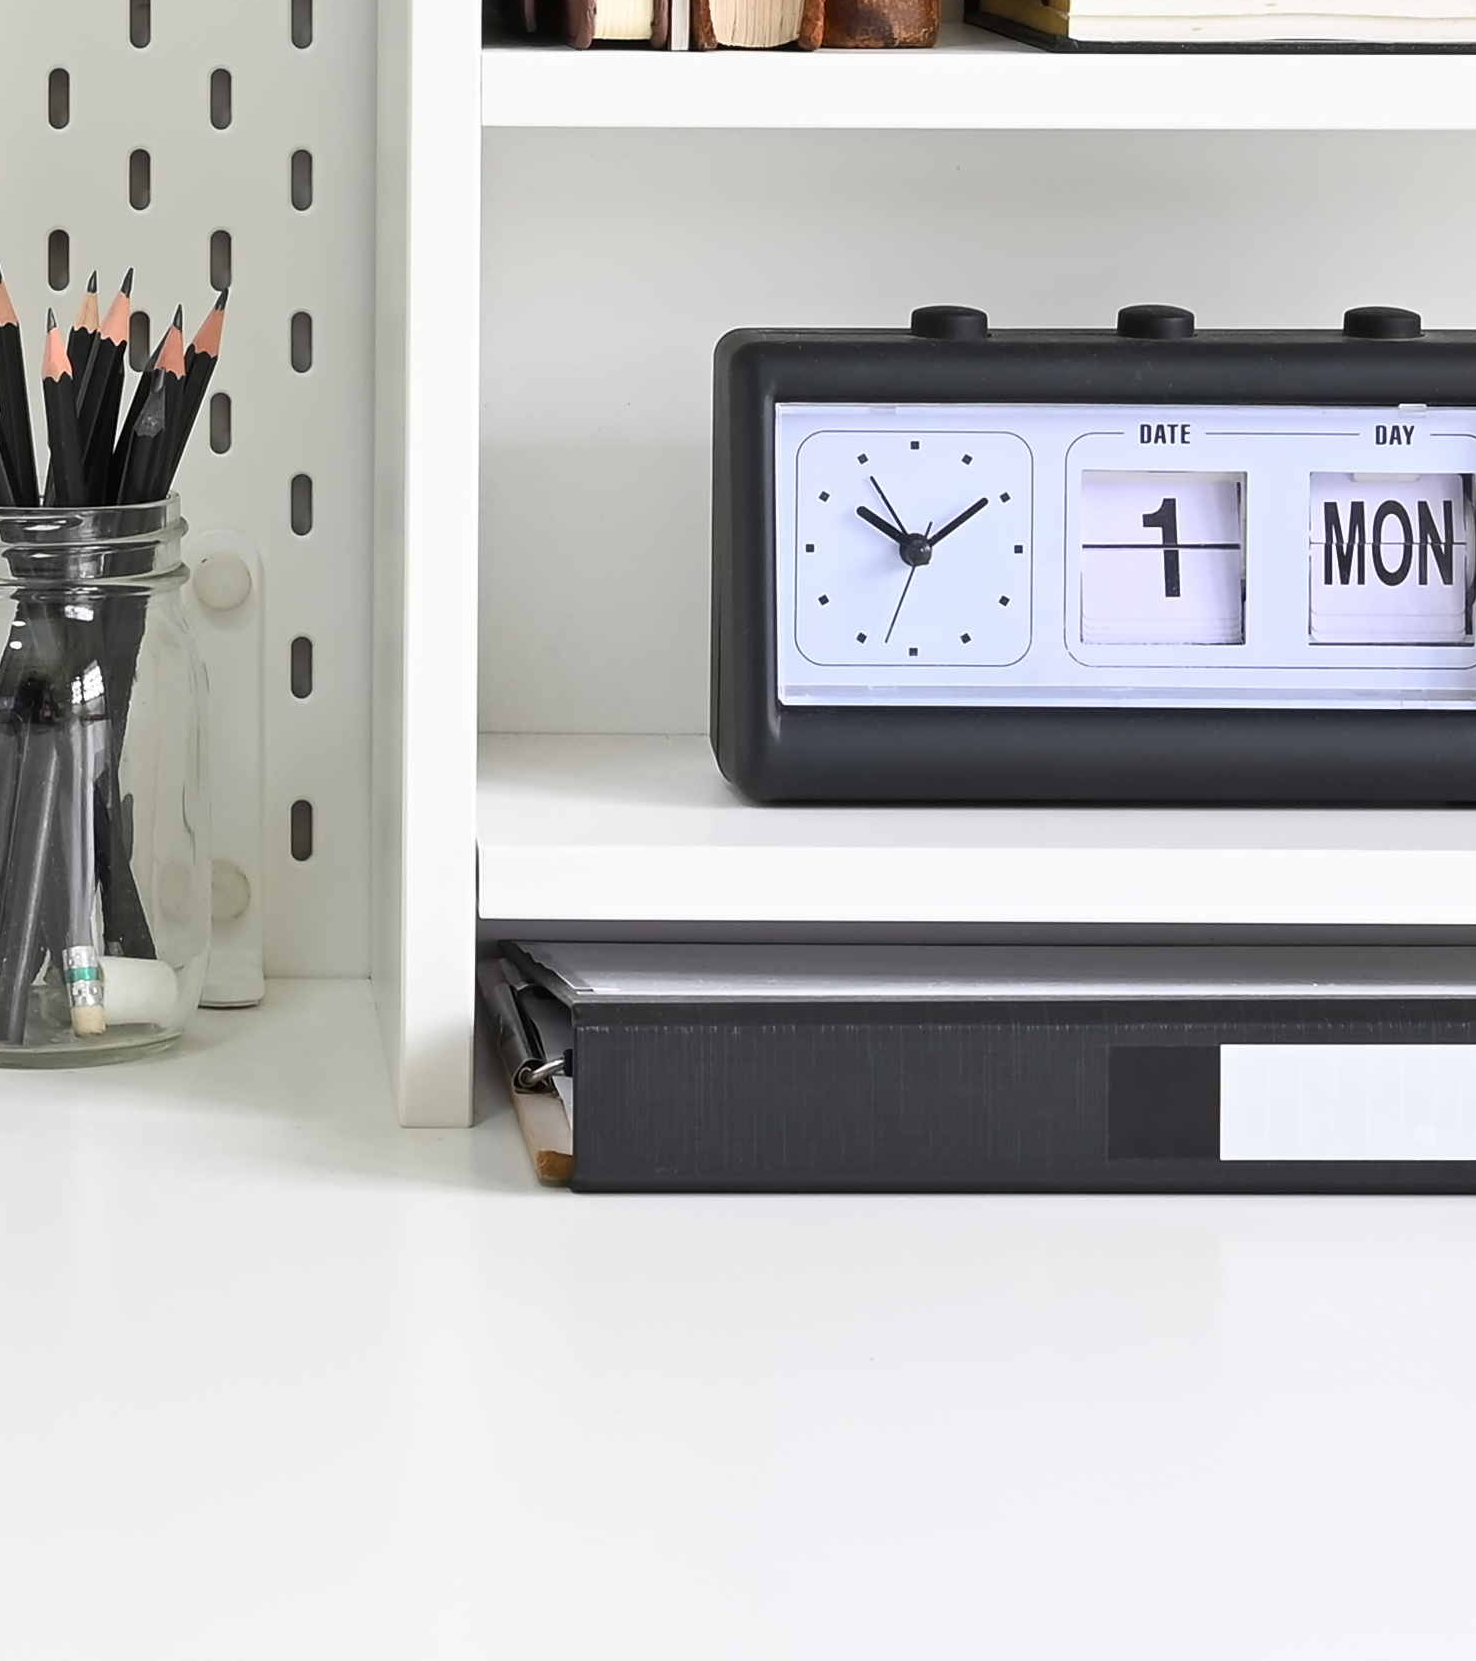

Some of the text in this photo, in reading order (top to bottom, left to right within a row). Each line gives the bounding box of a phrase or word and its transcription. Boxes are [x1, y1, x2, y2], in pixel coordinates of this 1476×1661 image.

[1140, 423, 1191, 444] DATE
[1375, 425, 1415, 446] DAY
[1142, 498, 1180, 597] 1
[1323, 500, 1453, 586] MON
